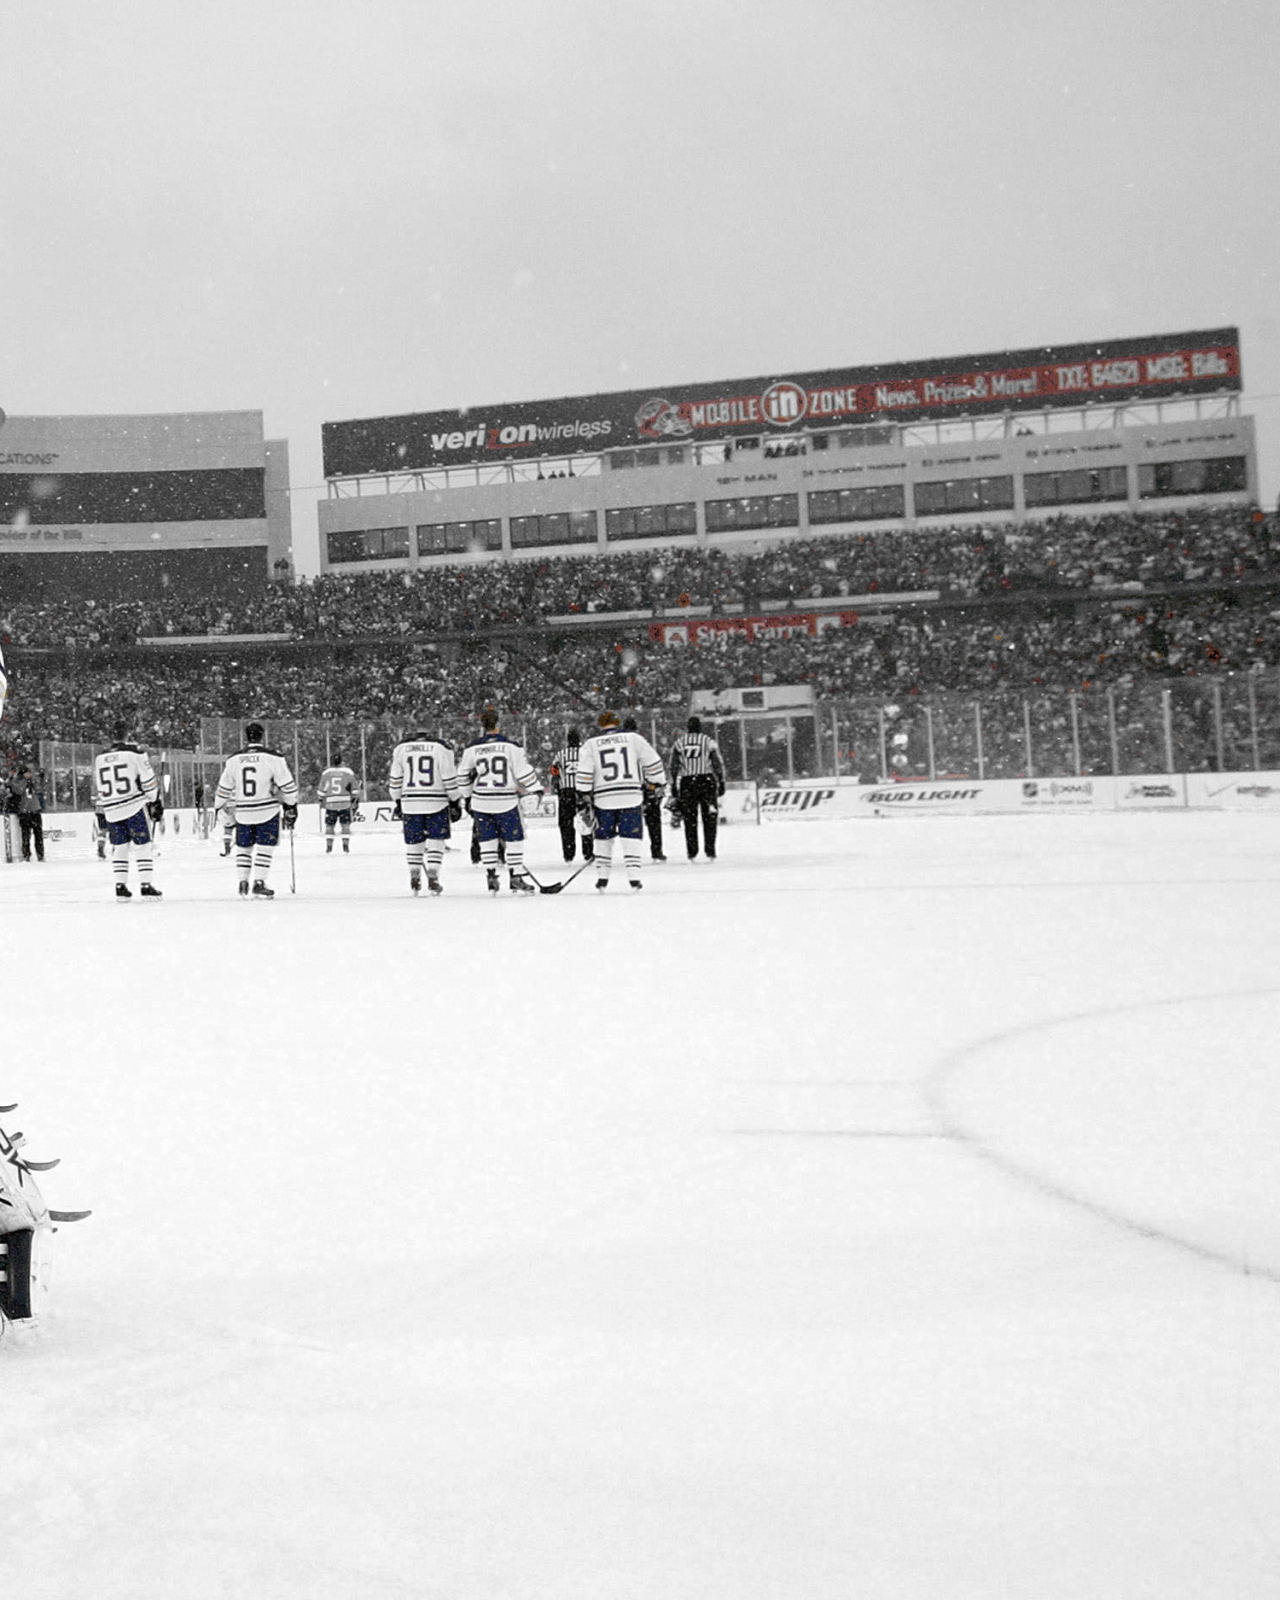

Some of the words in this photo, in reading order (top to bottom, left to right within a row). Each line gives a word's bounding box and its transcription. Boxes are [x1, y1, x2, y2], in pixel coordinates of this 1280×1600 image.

[692, 399, 758, 426] MOBILE
[770, 391, 799, 418] in
[810, 389, 857, 414] ZONE
[431, 423, 536, 450] verizon
[537, 420, 612, 440] wireless
[599, 746, 634, 782] 51
[684, 745, 701, 758] 77
[99, 763, 131, 797] 55
[242, 766, 257, 797] 6
[406, 755, 435, 788] 19
[475, 756, 508, 788] 29
[761, 789, 836, 811] amp
[868, 792, 914, 803] BUD
[917, 788, 983, 801] LIGHT
